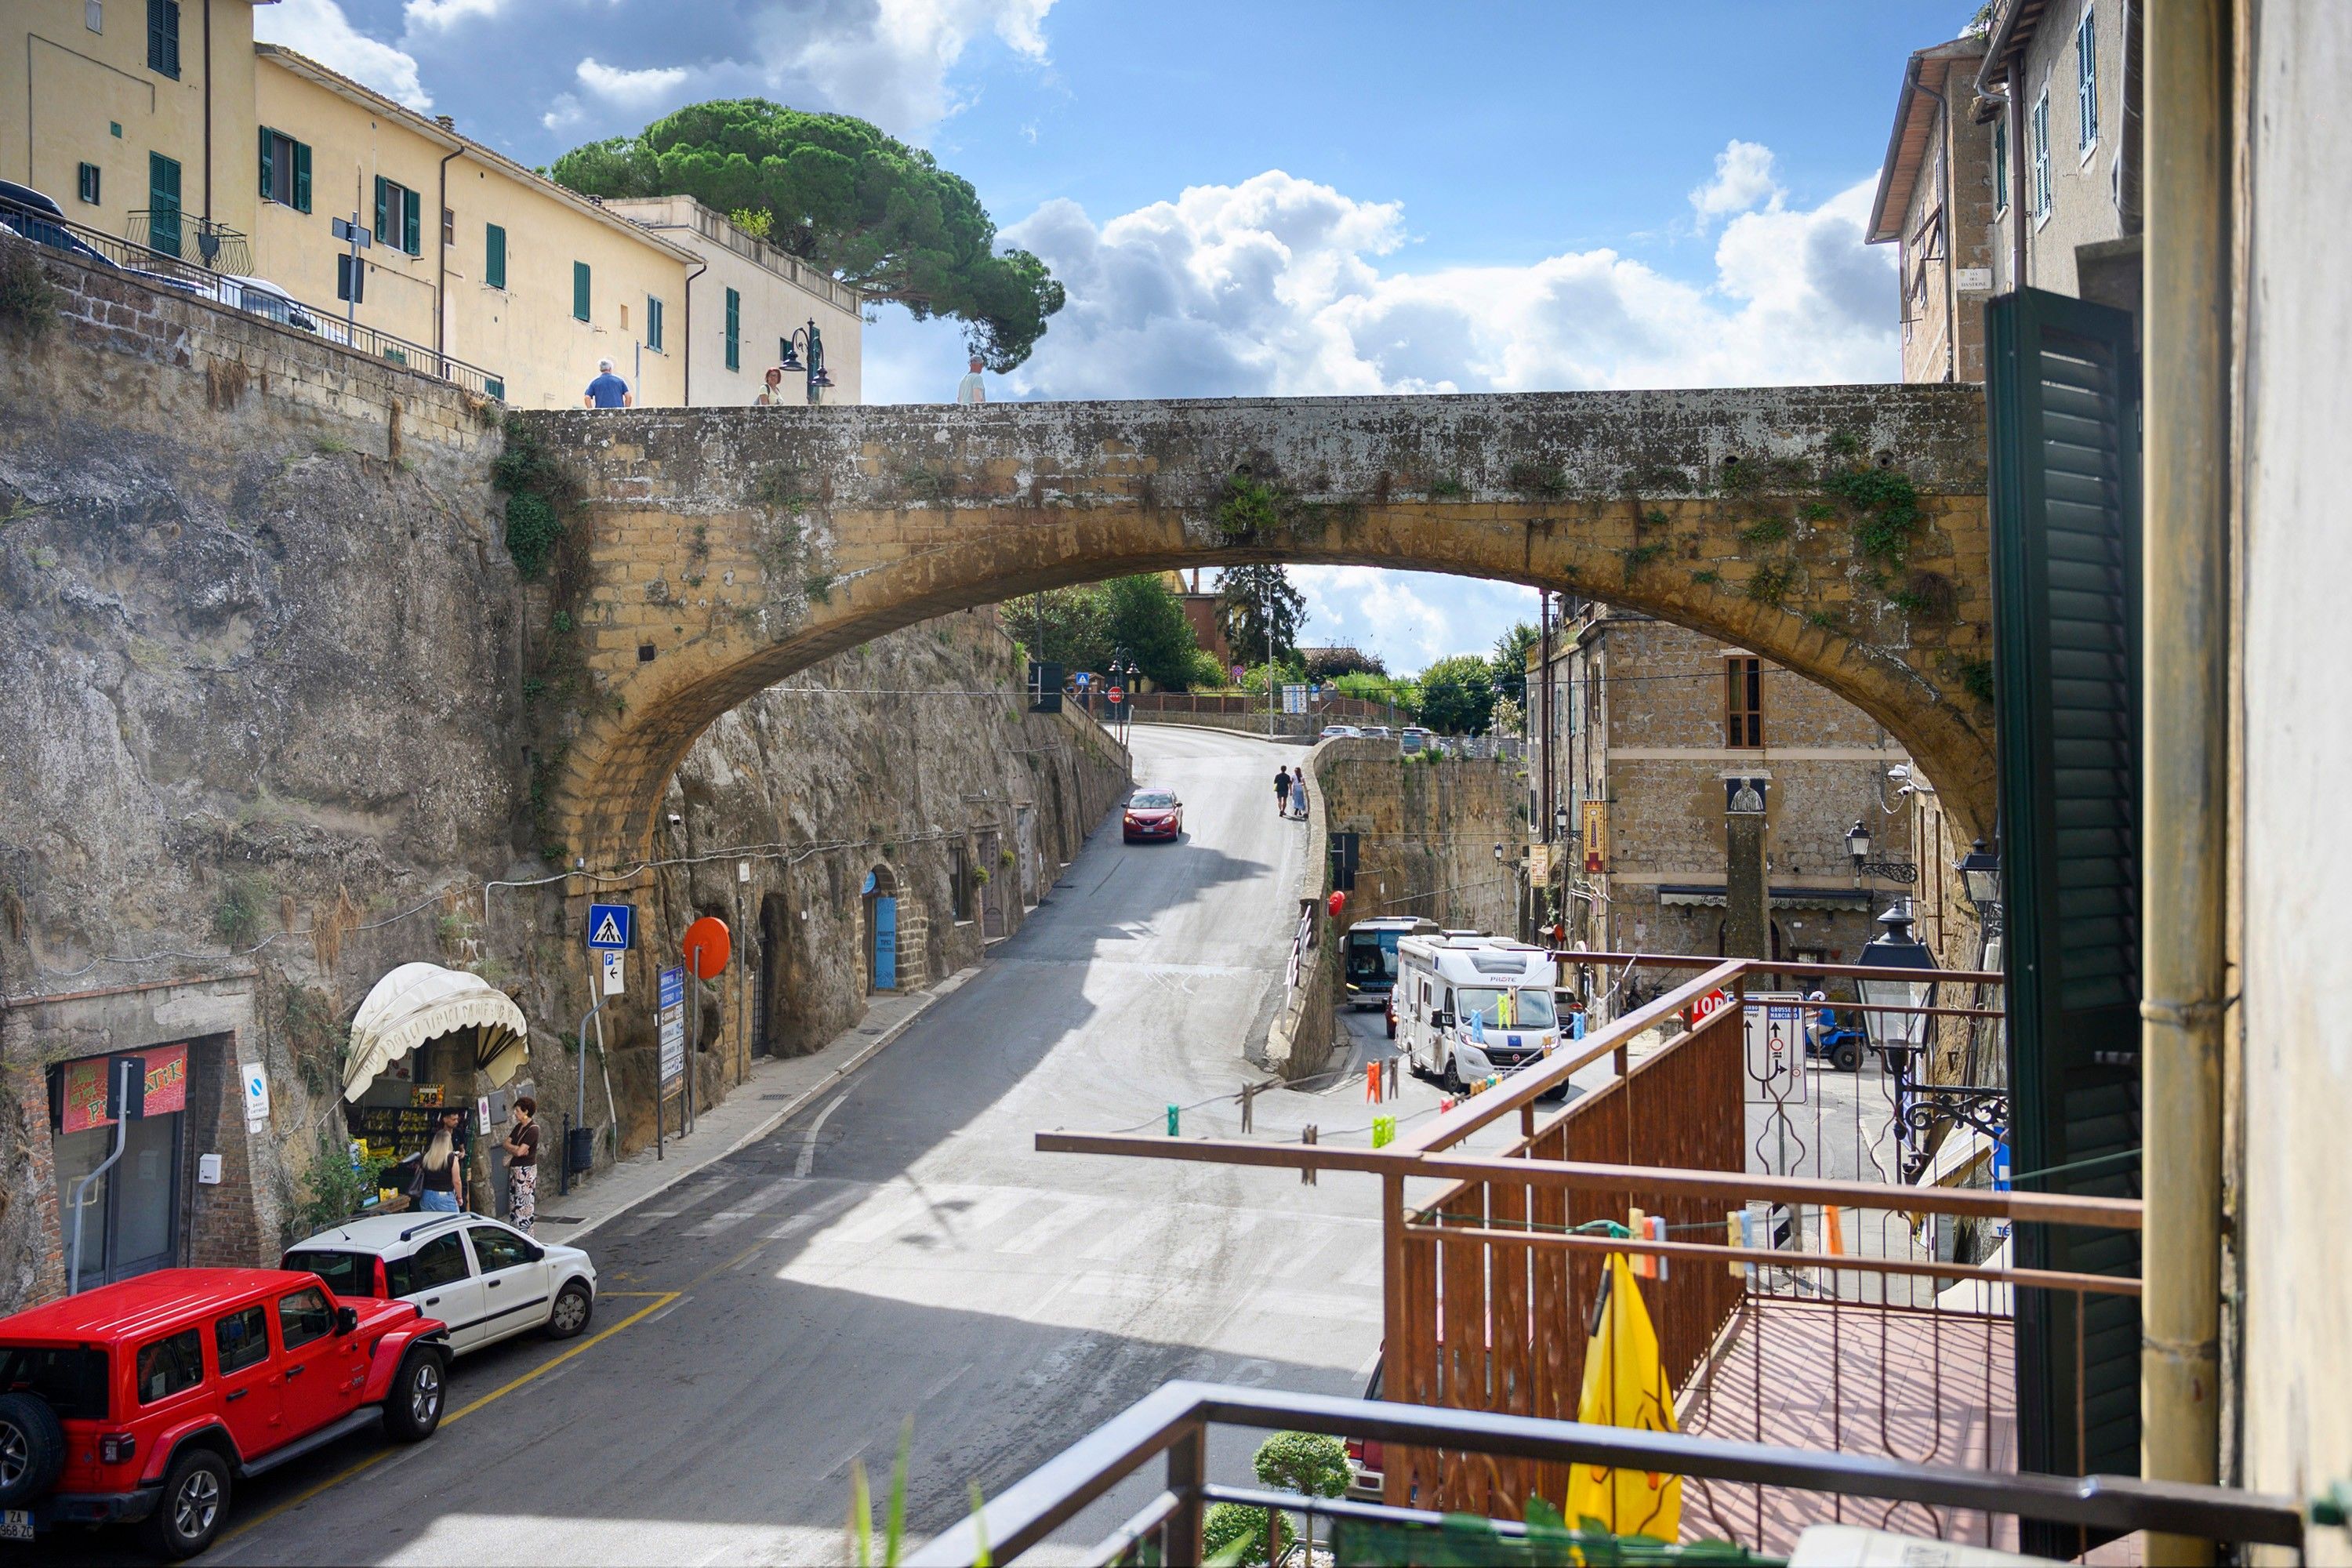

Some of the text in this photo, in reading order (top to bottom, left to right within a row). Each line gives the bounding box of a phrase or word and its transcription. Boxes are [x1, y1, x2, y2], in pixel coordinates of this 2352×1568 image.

[606, 954, 612, 965] P
[1693, 996, 1725, 1015] TOP
[10, 1511, 22, 1523] ZA
